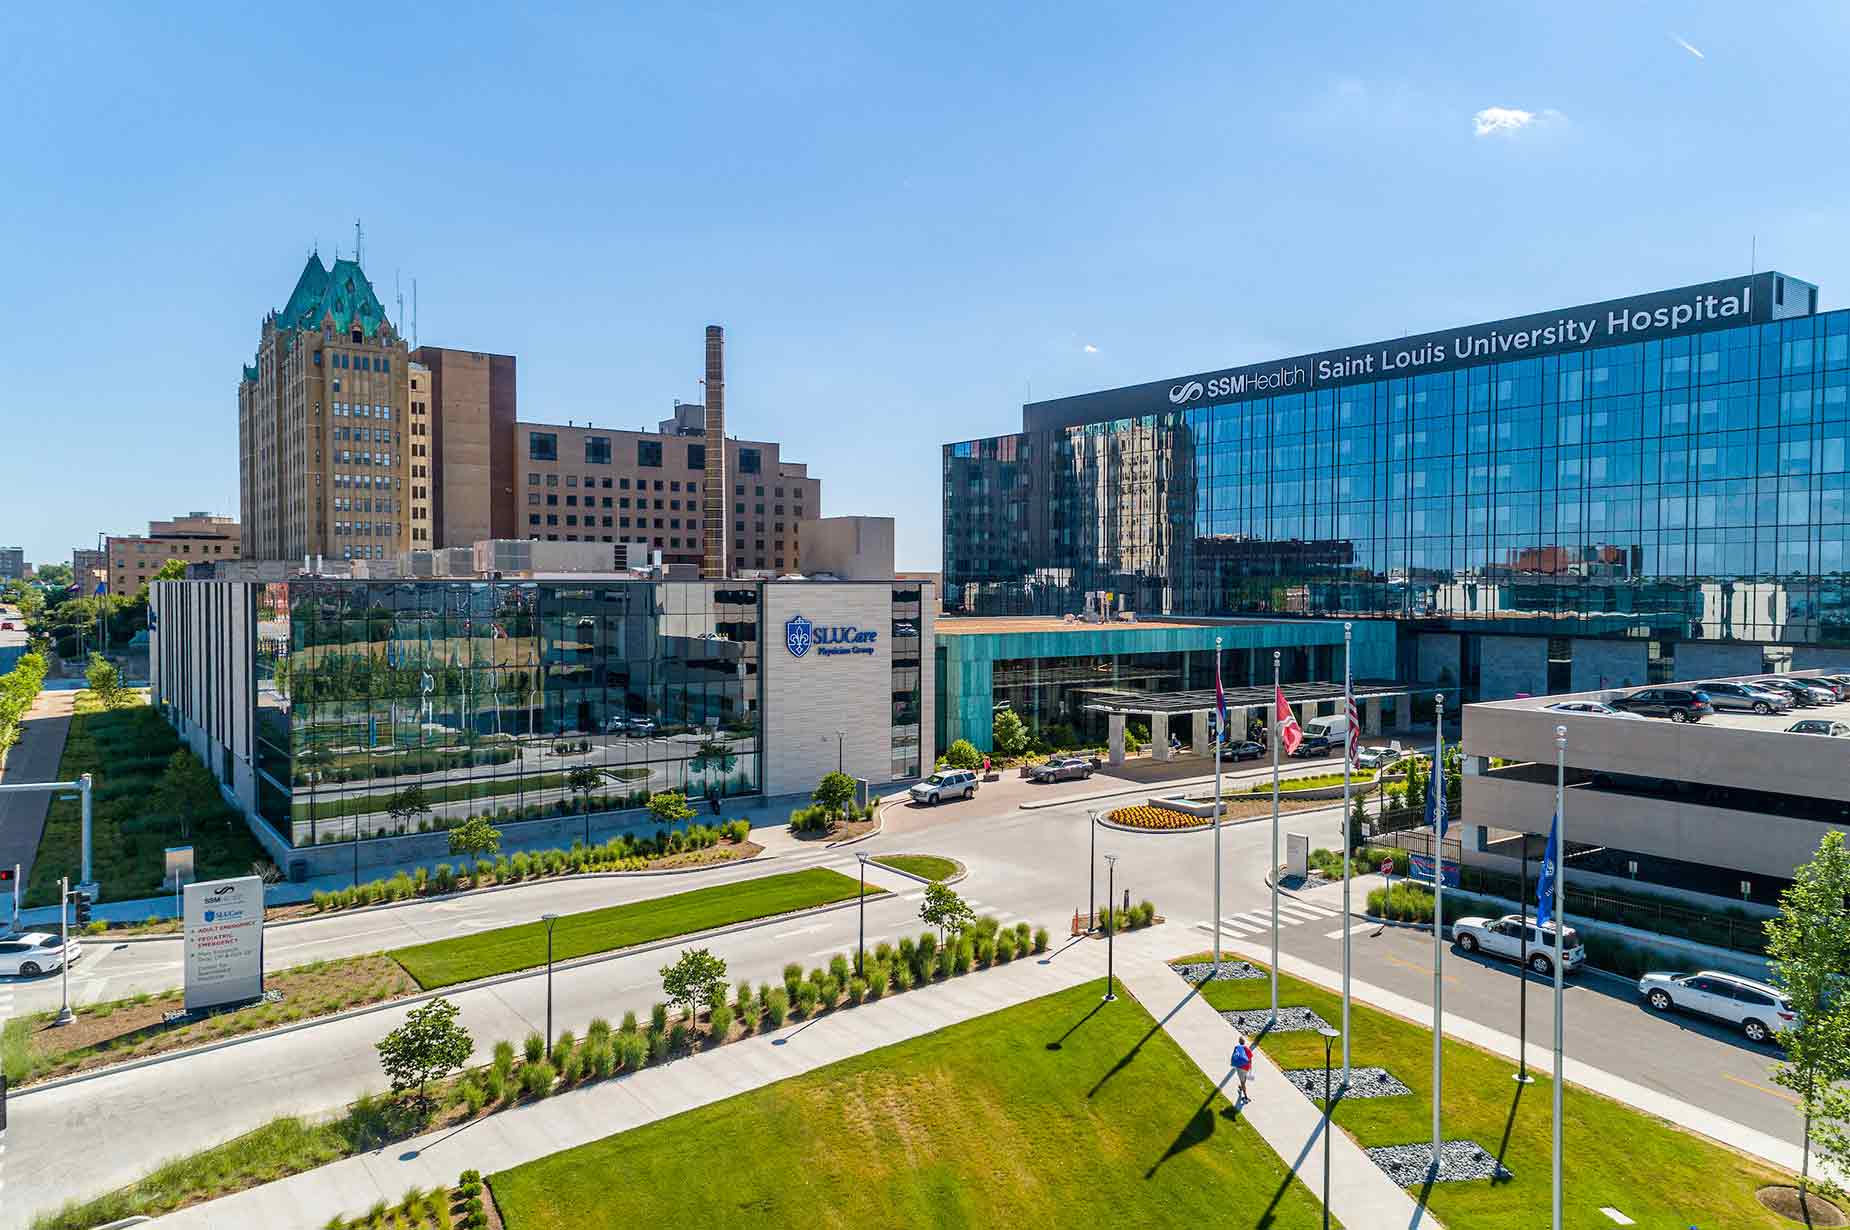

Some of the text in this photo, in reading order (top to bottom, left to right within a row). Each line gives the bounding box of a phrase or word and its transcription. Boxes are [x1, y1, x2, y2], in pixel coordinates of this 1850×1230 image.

[1207, 287, 1751, 398] SSMHealth Saint Louis University Hospital
[813, 626, 878, 644] SLUCare
[198, 926, 219, 934] ADULT
